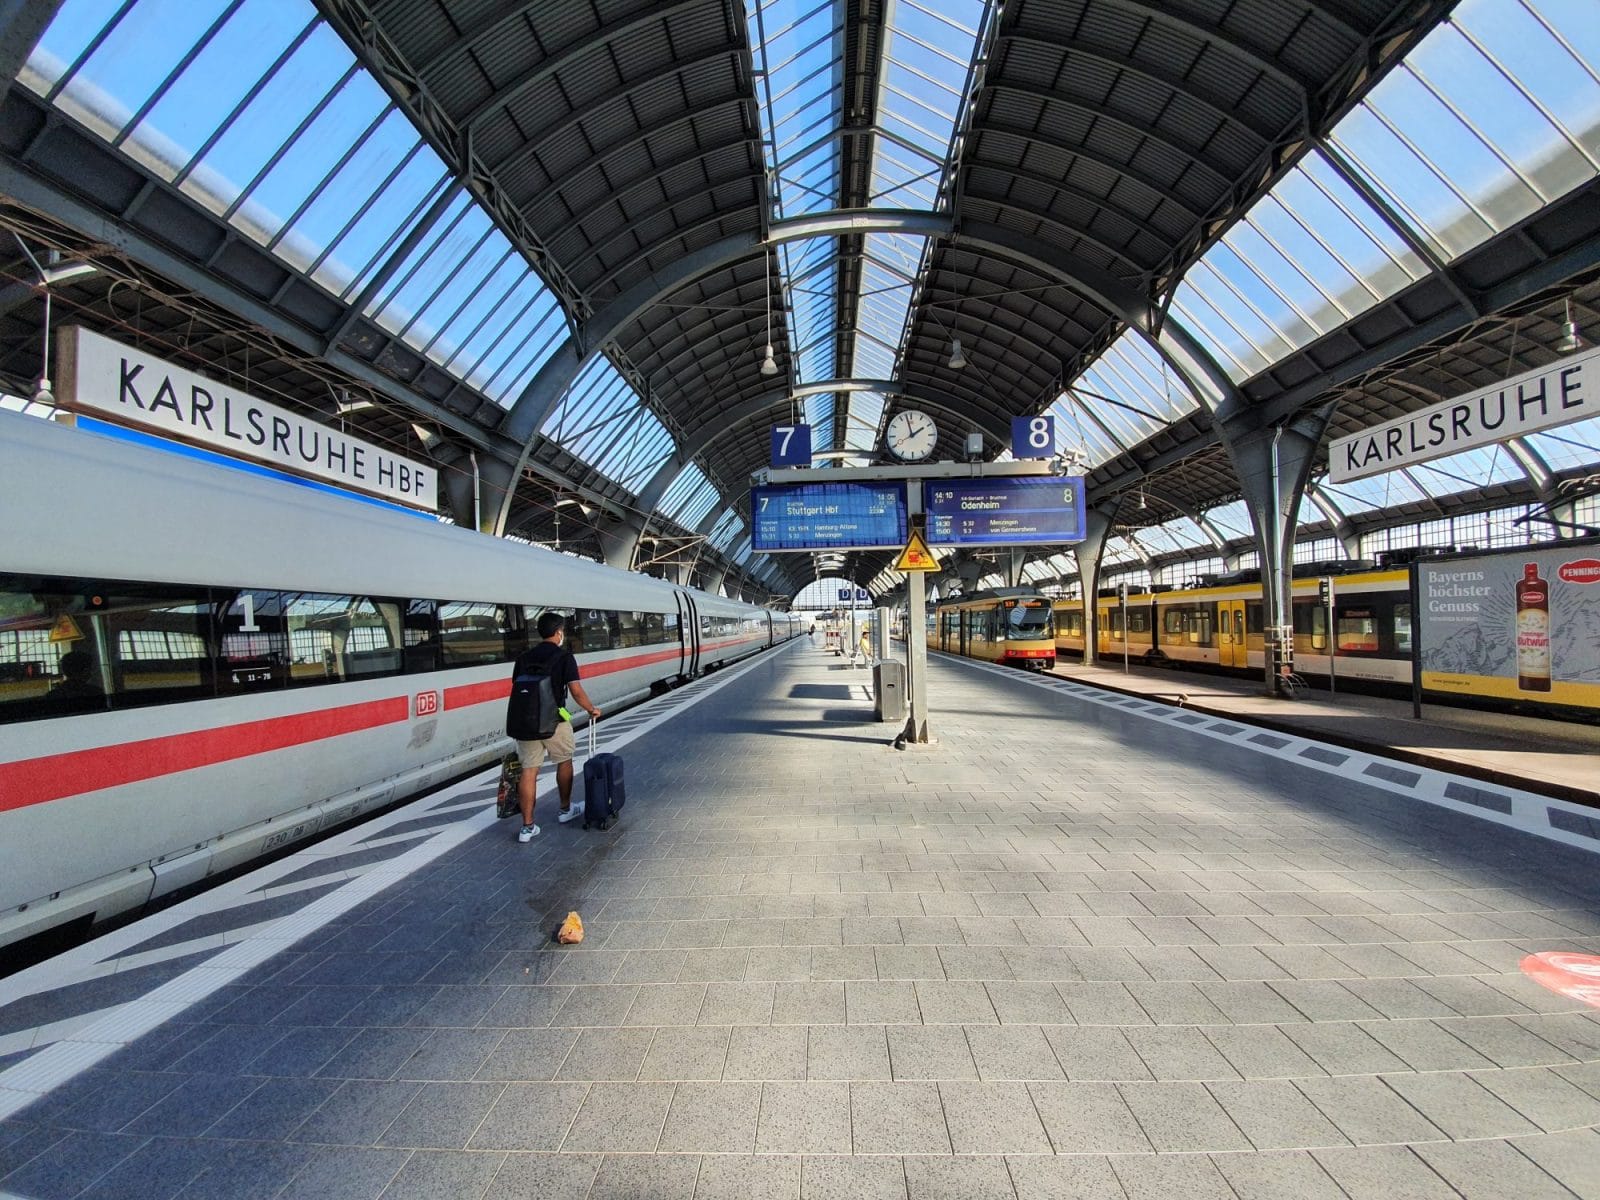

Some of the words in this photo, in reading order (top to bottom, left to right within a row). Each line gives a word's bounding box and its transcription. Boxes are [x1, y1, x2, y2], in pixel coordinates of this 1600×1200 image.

[1346, 365, 1585, 471] KARLSRUHE
[119, 357, 366, 480] KARLSRUHE
[377, 455, 426, 497] HBF
[1028, 417, 1051, 449] 8
[775, 426, 796, 457] 7
[934, 491, 953, 499] 14:10
[1063, 488, 1073, 503] 8
[760, 497, 769, 512] 7
[786, 506, 823, 516] Stuttgart
[825, 505, 839, 515] Hbf
[960, 501, 1000, 510] Odenheim
[1428, 570, 1485, 585] Bayerns
[1562, 566, 1600, 577] PENNING
[842, 589, 849, 599] D
[860, 589, 867, 598] D
[1428, 584, 1491, 598] höchster
[237, 594, 260, 632] 1
[1428, 600, 1480, 612] Genuss
[419, 694, 435, 712] DB
